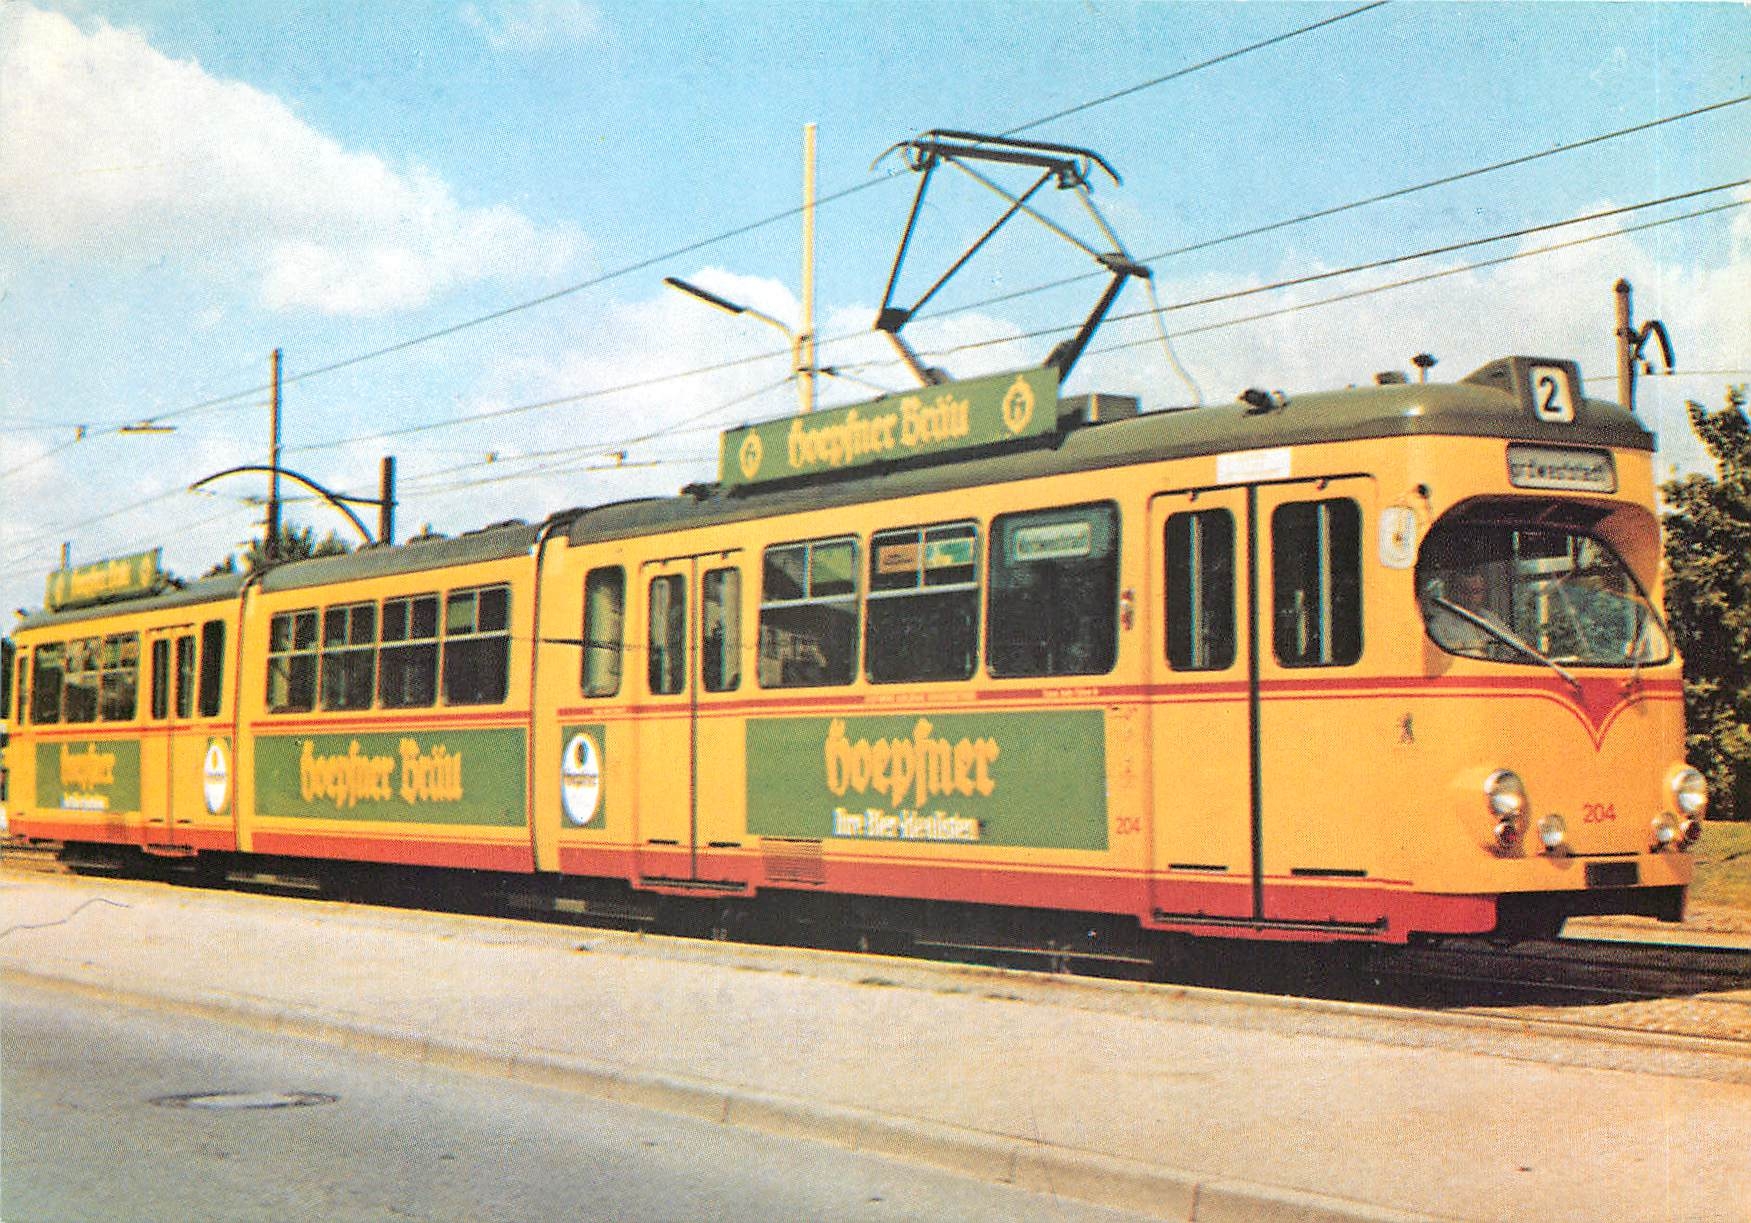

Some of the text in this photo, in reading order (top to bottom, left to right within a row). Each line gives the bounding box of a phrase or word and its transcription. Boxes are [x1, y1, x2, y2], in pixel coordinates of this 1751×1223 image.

[1540, 376, 1562, 412] 2
[1584, 803, 1616, 823] 204
[1116, 817, 1141, 834] 204
